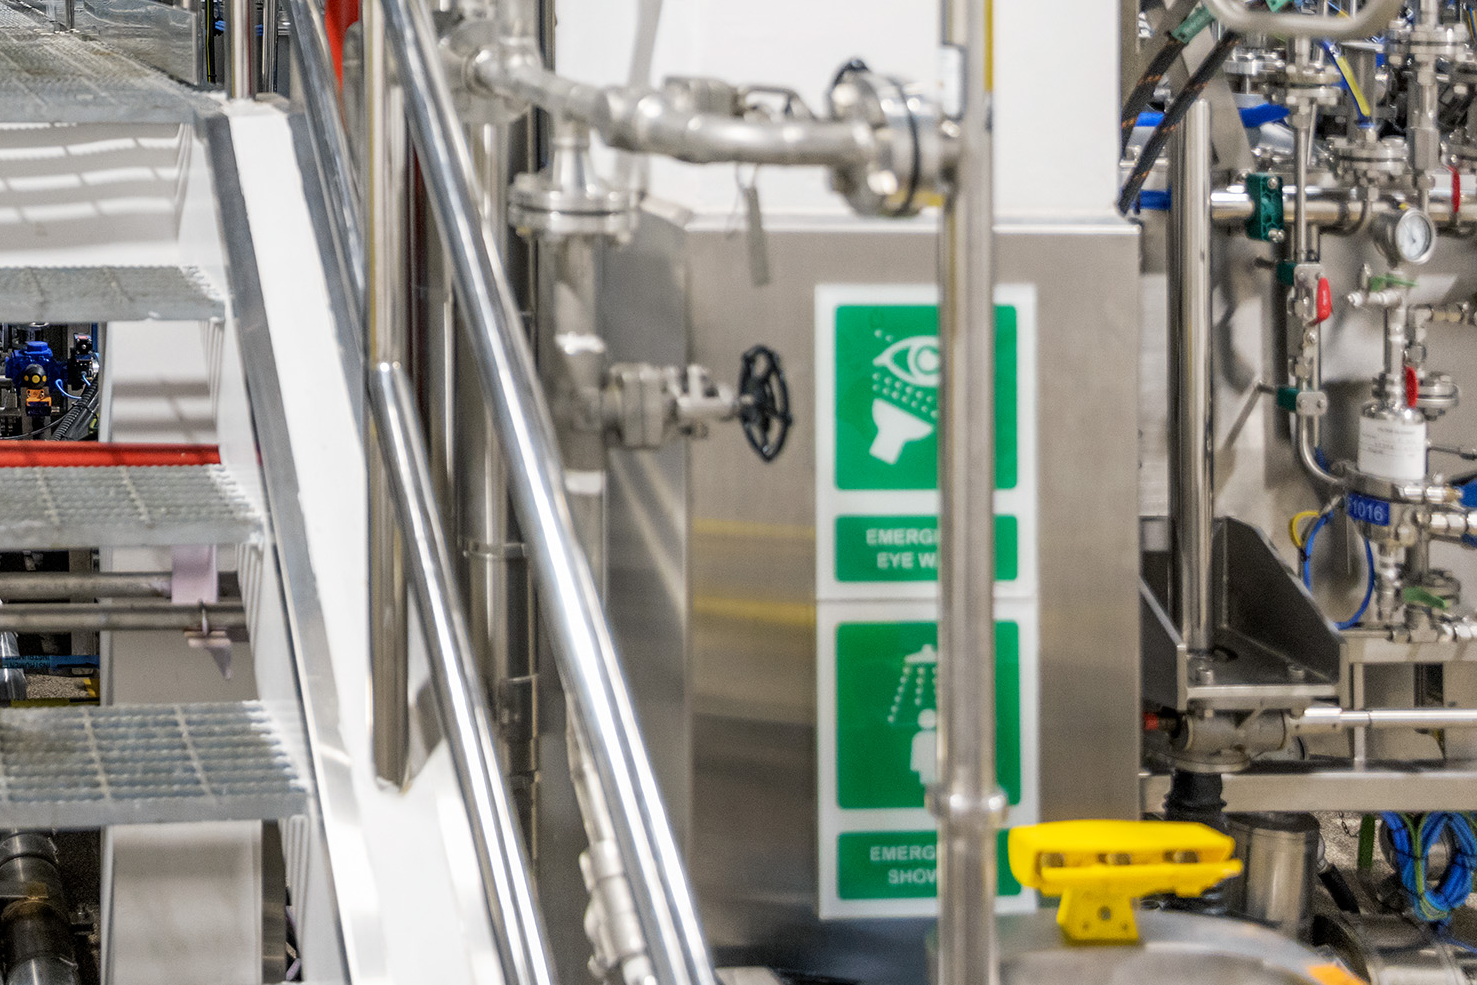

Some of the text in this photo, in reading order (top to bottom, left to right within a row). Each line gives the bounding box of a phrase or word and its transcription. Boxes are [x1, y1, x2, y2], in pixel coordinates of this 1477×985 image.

[866, 527, 940, 546] EMERG
[877, 552, 914, 569] EYE
[869, 845, 937, 862] EMERG
